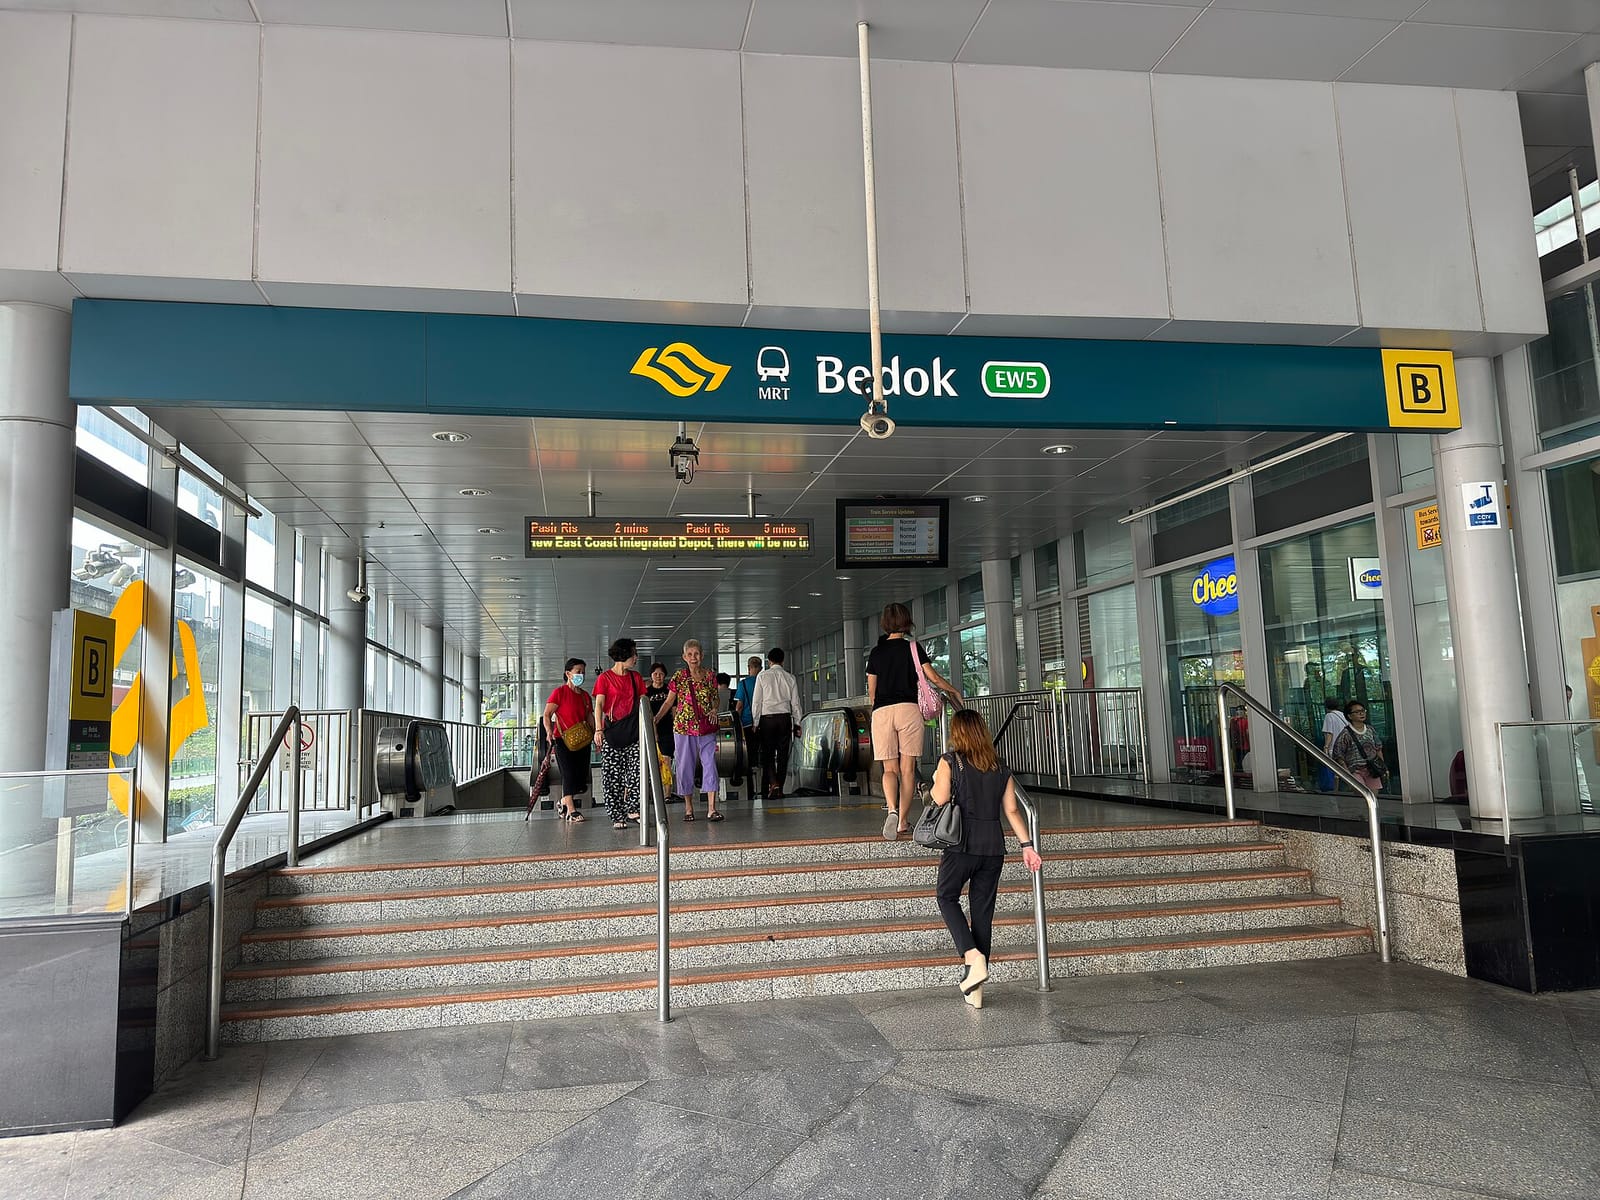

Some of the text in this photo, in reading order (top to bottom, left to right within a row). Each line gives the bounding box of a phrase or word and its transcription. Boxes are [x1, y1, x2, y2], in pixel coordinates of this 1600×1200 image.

[816, 355, 1038, 397] Bedok EW5
[758, 386, 790, 400] MRT
[1411, 373, 1431, 404] B
[1419, 510, 1428, 518] Bus
[1420, 516, 1439, 526] towards
[531, 522, 649, 533] Pasir Ris 2 mins
[686, 523, 796, 534] Pasir Ris 5 mins
[555, 536, 581, 548] East
[584, 536, 618, 548] Coast
[717, 536, 745, 548] there
[747, 536, 765, 548] will
[767, 536, 781, 548] be
[783, 540, 797, 548] no
[1192, 573, 1238, 604] Chee
[89, 648, 99, 685] B
[1180, 744, 1207, 753] UNLIMITED
